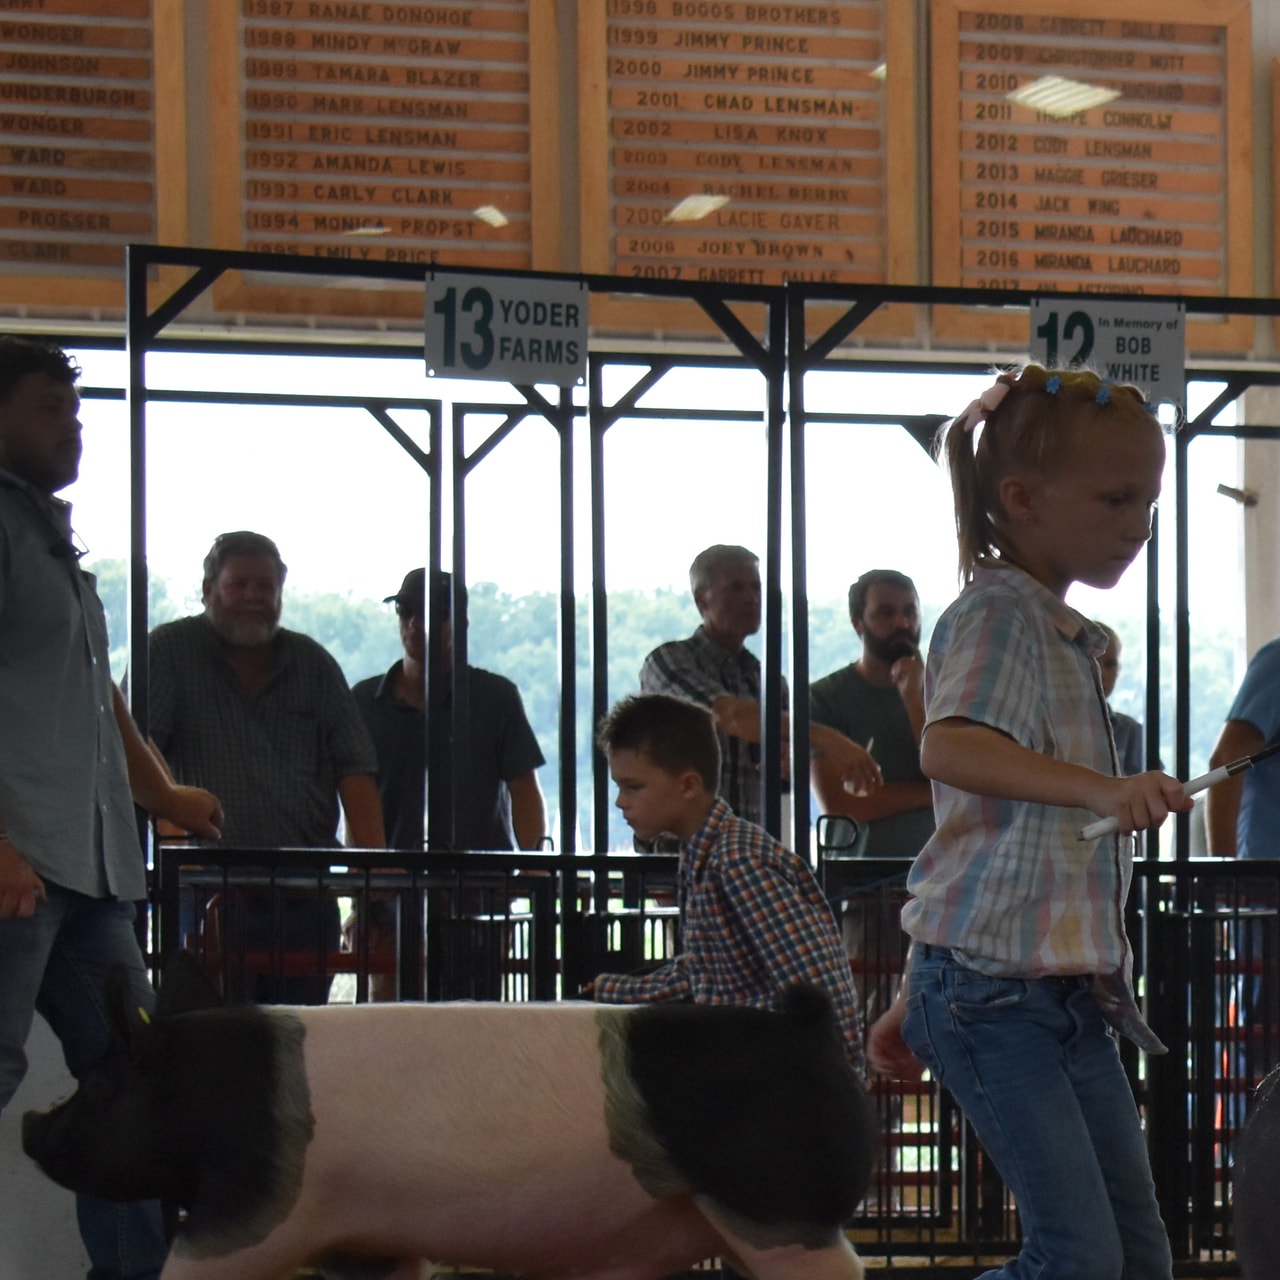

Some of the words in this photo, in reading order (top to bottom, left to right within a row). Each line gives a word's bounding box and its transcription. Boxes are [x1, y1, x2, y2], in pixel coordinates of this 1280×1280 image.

[249, 0, 293, 17] 1987
[309, 3, 371, 21] RANAE
[383, 9, 472, 26] DONOHOE
[613, 0, 657, 16] 1998
[746, 7, 842, 25] BROTHERS
[976, 14, 1024, 31] 2008
[249, 30, 297, 46] 1988
[312, 34, 372, 52] MINDY
[613, 28, 658, 45] 1999
[673, 32, 730, 49] JIMMY
[742, 36, 809, 54] PRINCE
[976, 43, 1024, 62] 2009
[6, 56, 98, 72] JOHNSON
[249, 61, 297, 79] 1989
[313, 65, 390, 84] TAMARA
[405, 71, 481, 88] BLAZER
[614, 59, 662, 76] 2000
[683, 63, 738, 81] JIMMY
[748, 66, 815, 84] PRINCE
[976, 73, 1018, 91] 2010
[249, 93, 297, 110] 1990
[312, 96, 363, 113] MARK
[377, 101, 468, 118] LENSMAN
[636, 91, 680, 109] 2001
[704, 93, 754, 110] CHAD
[765, 97, 853, 116] LENSMAN
[976, 102, 1012, 121] 2011
[249, 124, 293, 142] 1991
[309, 127, 353, 143] ERIC
[366, 130, 457, 147] LENSMAN
[623, 120, 673, 138] 2002
[714, 125, 759, 142] LISA
[777, 127, 828, 144] KNOX
[10, 148, 66, 166] WARD
[976, 132, 1018, 150] 2012
[1086, 139, 1153, 159] LENSMAN
[252, 153, 298, 170] 1992
[313, 155, 393, 173] AMANDA
[407, 160, 466, 176] LEWIS
[624, 149, 668, 165] 2003
[696, 152, 742, 170] CODY
[759, 155, 854, 174] LENSMAN
[976, 162, 1019, 181] 2013
[1034, 165, 1085, 185] MAGGIE
[12, 180, 67, 196] WARD
[250, 183, 299, 200] 1993
[313, 186, 377, 203] CARLY
[391, 189, 453, 206] CLARK
[625, 180, 671, 195] 2004
[703, 183, 779, 200] RACHEL
[788, 187, 851, 203] BERRY
[976, 191, 1018, 209] 2014
[1036, 195, 1070, 212] JACK
[18, 211, 111, 229] PROSSER
[250, 213, 299, 230] 1994
[313, 216, 386, 231] MONICA
[401, 219, 476, 238] PROPST
[716, 211, 767, 230] LACIE
[781, 213, 840, 233] GAVER
[977, 221, 1019, 238] 2015
[1034, 224, 1095, 244] MIRANDA
[8, 242, 71, 261] CLARK
[629, 239, 675, 255] 2006
[698, 240, 746, 256] JOEY
[756, 242, 824, 259] BROWN
[977, 249, 1018, 267] 2016
[1034, 253, 1092, 271] MIRANDA
[499, 299, 579, 329] YODER
[1098, 317, 1110, 328] In
[1114, 317, 1161, 331] Memory
[1166, 319, 1178, 331] of
[433, 286, 494, 371] 13
[1037, 310, 1095, 370] 12
[499, 336, 579, 366] FARMS
[1115, 335, 1152, 355] BOB
[1105, 362, 1160, 383] WHITE
